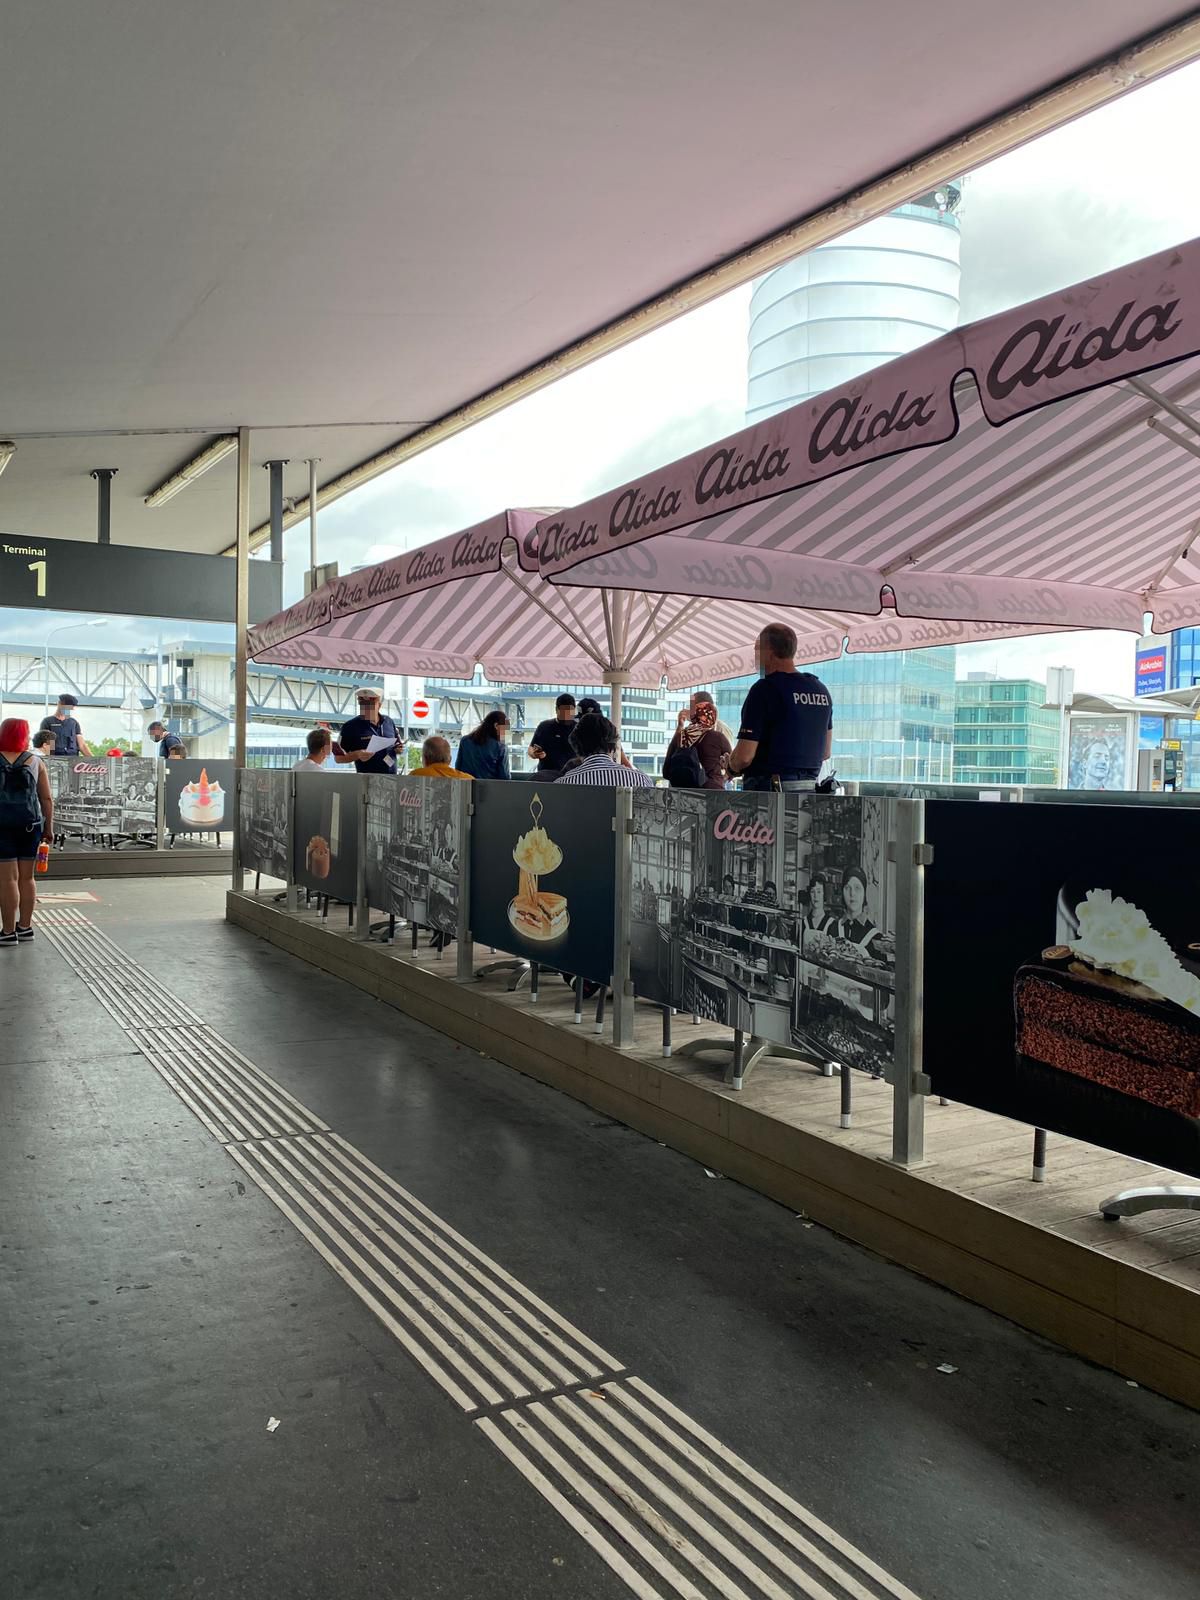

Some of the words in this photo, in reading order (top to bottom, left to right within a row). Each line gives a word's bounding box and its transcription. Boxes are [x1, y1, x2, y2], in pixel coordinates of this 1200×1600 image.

[2, 544, 47, 556] Terminal
[28, 560, 47, 597] 1
[792, 692, 830, 706] POLIZEI
